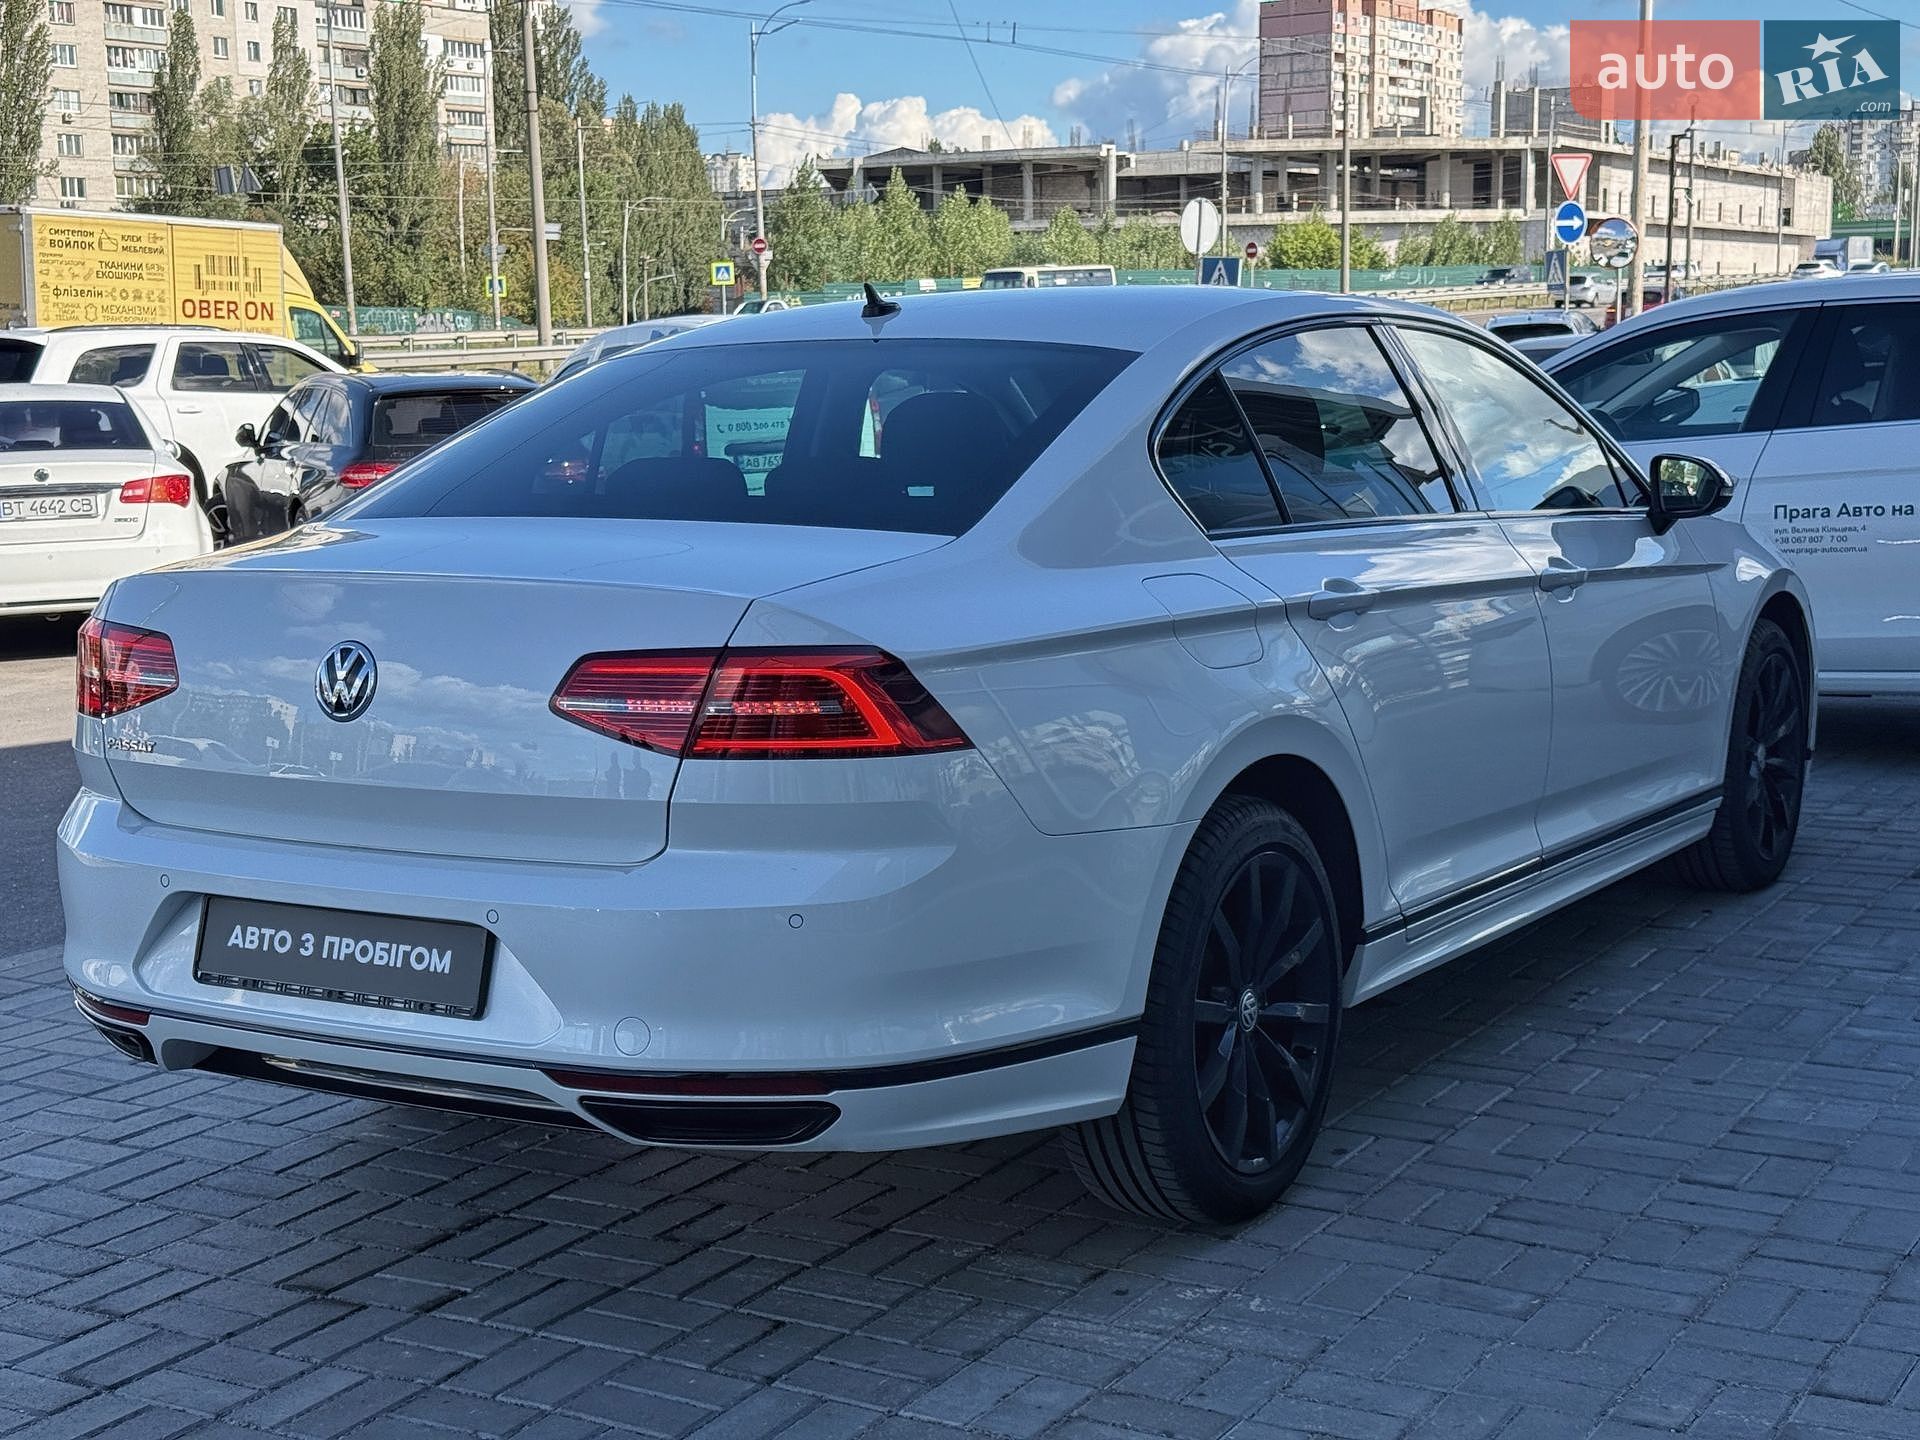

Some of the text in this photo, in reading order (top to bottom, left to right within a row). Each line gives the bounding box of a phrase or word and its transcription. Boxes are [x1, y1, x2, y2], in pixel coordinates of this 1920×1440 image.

[49, 237, 95, 250] ВОЙЛОК
[98, 260, 143, 271] ТКАНИНИ
[95, 270, 144, 280] ЕКОШКІРА
[52, 285, 103, 299] флізелін
[101, 305, 157, 316] МЕХАНІЗМИ
[182, 298, 274, 320] OBERON
[2, 498, 93, 516] BT 4642 CB
[1773, 502, 1915, 523] Прага Авто на
[107, 737, 157, 753] PASSAT
[227, 924, 292, 954] АВТО
[322, 935, 452, 974] ПРОБІГОМ
